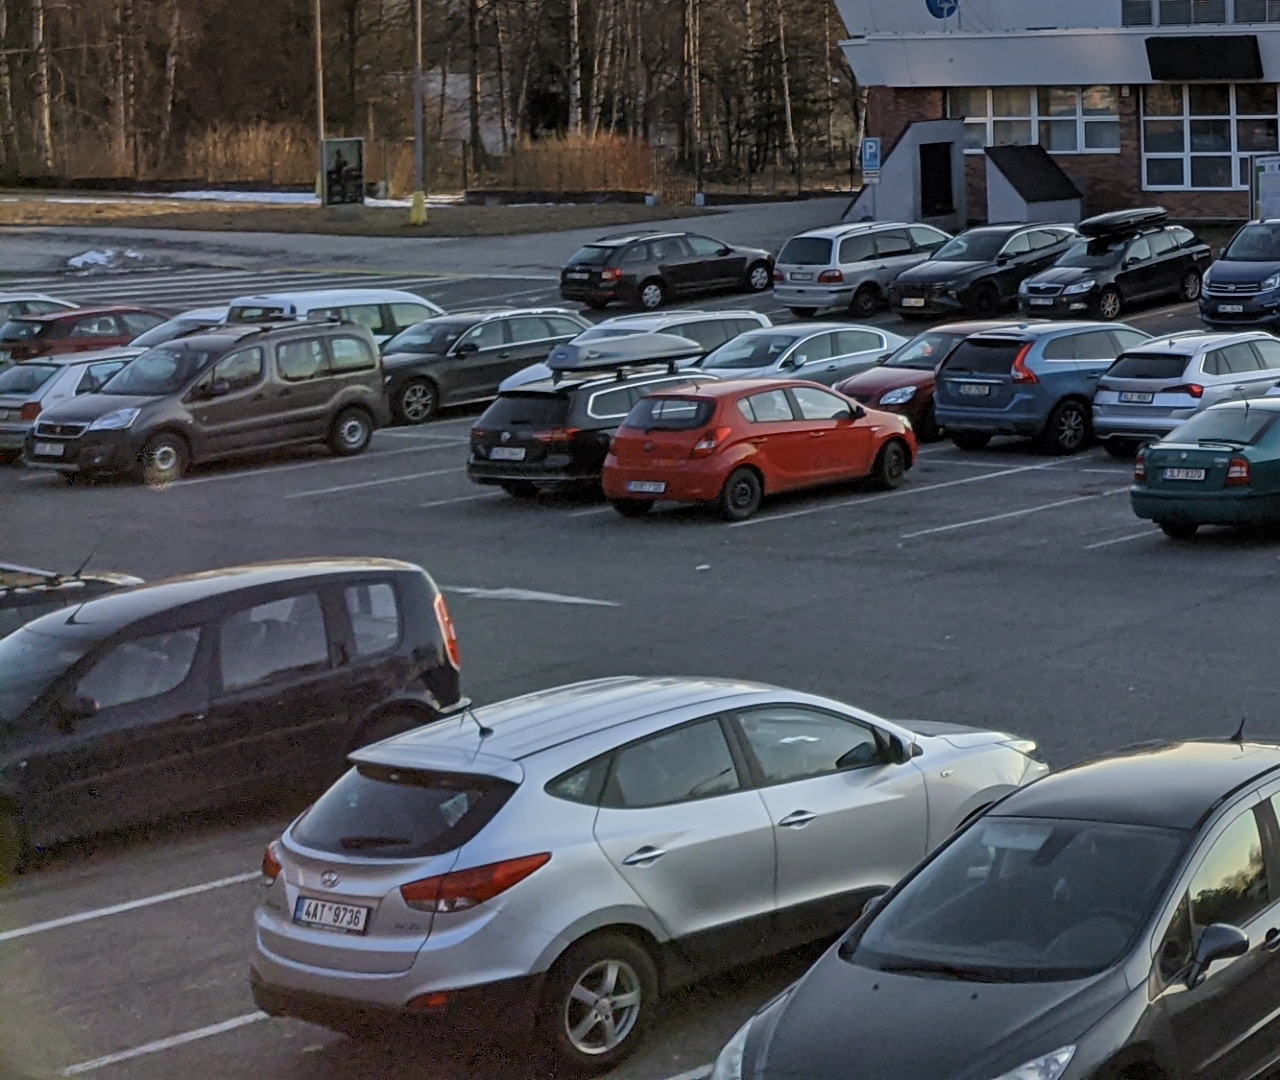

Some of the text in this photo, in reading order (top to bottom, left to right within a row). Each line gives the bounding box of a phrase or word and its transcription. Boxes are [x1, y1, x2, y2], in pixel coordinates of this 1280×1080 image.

[866, 142, 876, 160] P
[305, 901, 362, 928] 4AT 9736
